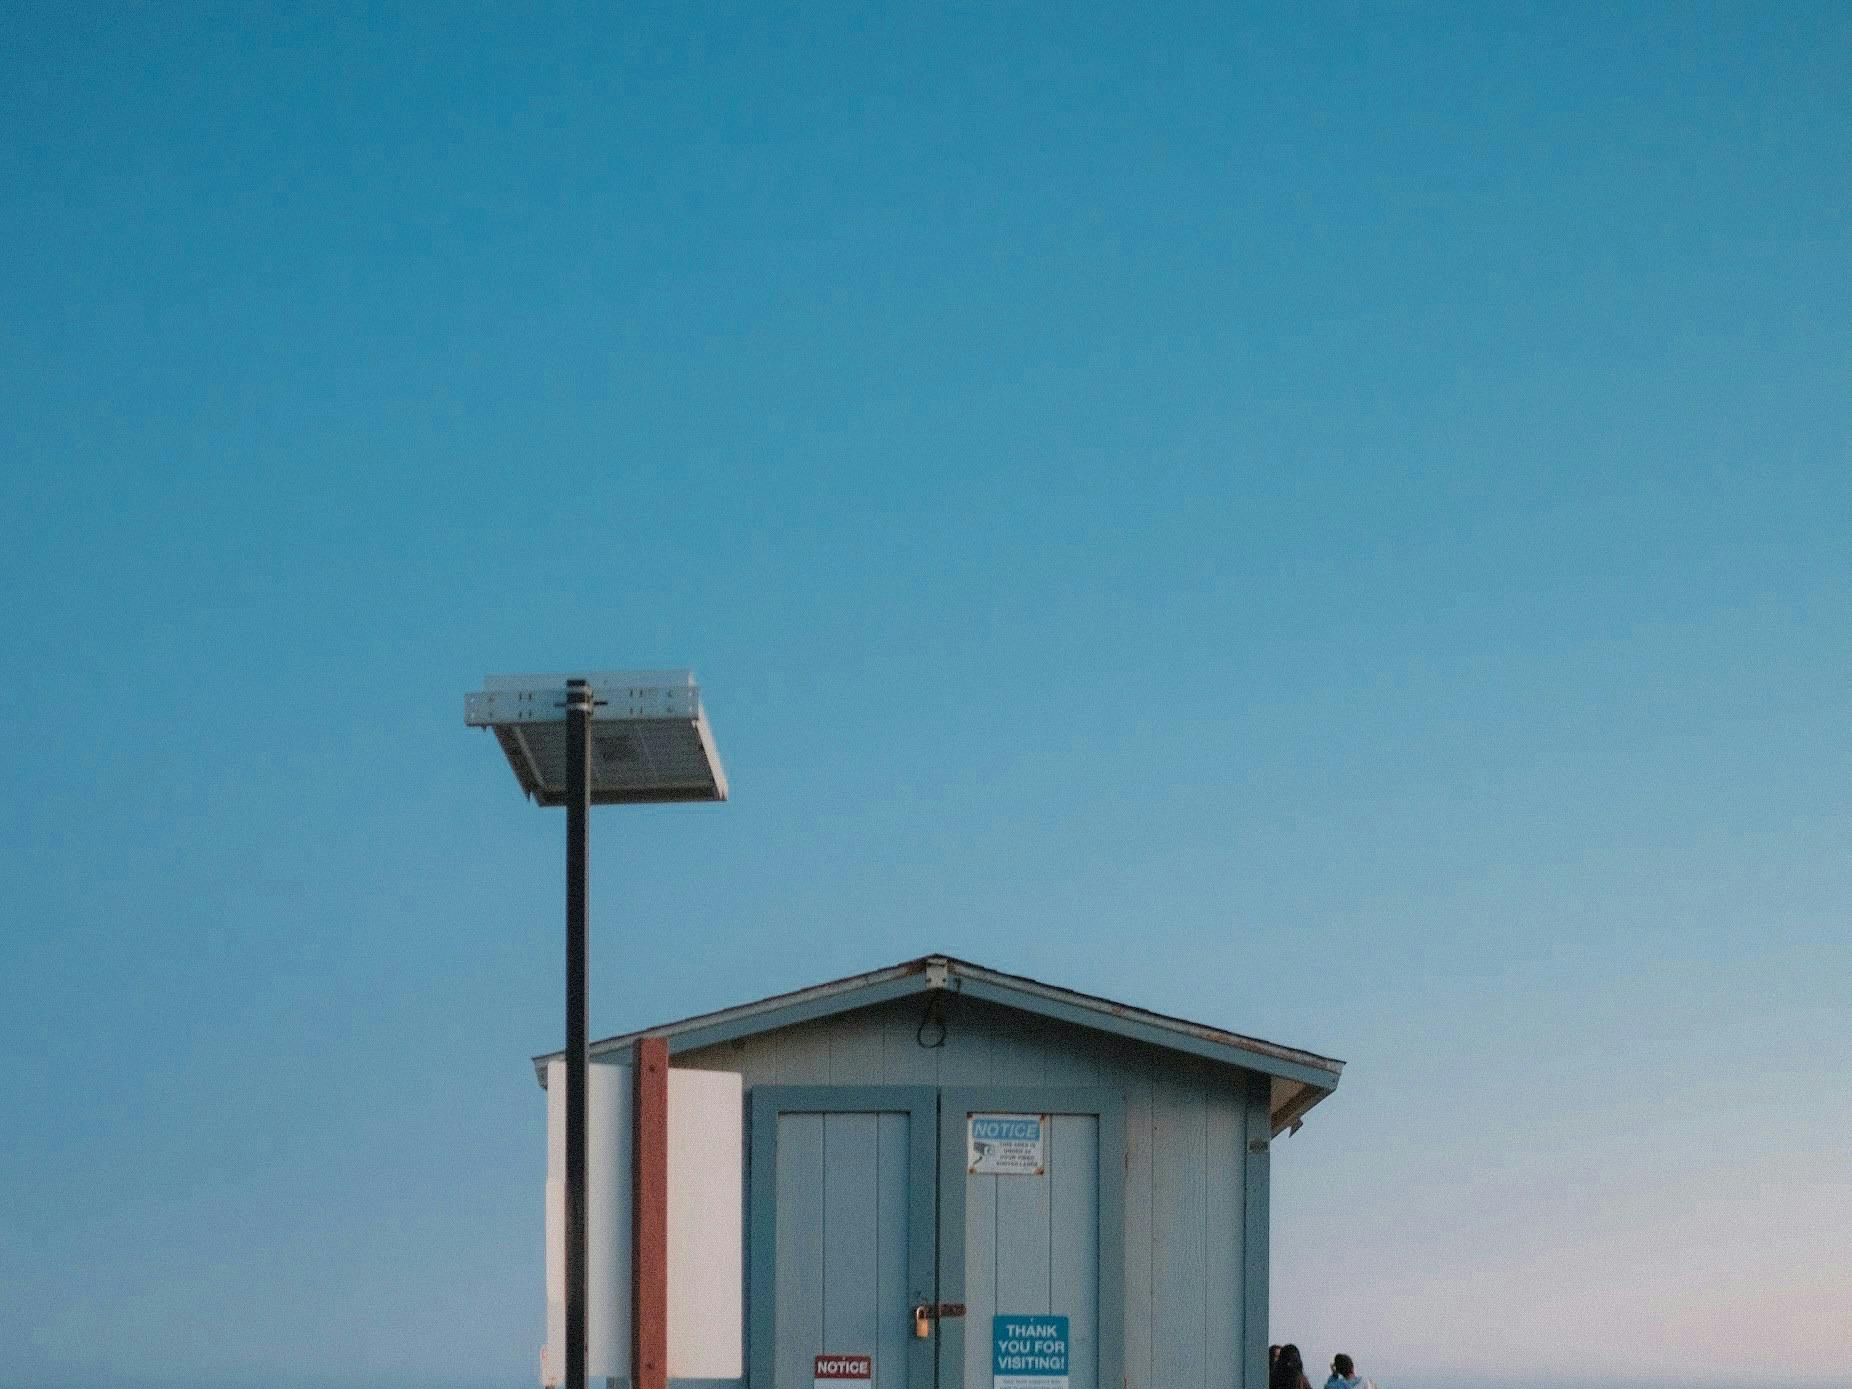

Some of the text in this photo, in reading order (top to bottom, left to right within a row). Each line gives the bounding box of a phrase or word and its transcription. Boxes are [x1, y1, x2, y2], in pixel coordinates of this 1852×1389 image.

[974, 1122, 1038, 1137] NOTICE
[1006, 1324, 1057, 1337] THANK
[998, 1340, 1065, 1353] YOU FOR
[817, 1360, 868, 1374] NOTICE
[998, 1356, 1065, 1370] VISITING!
